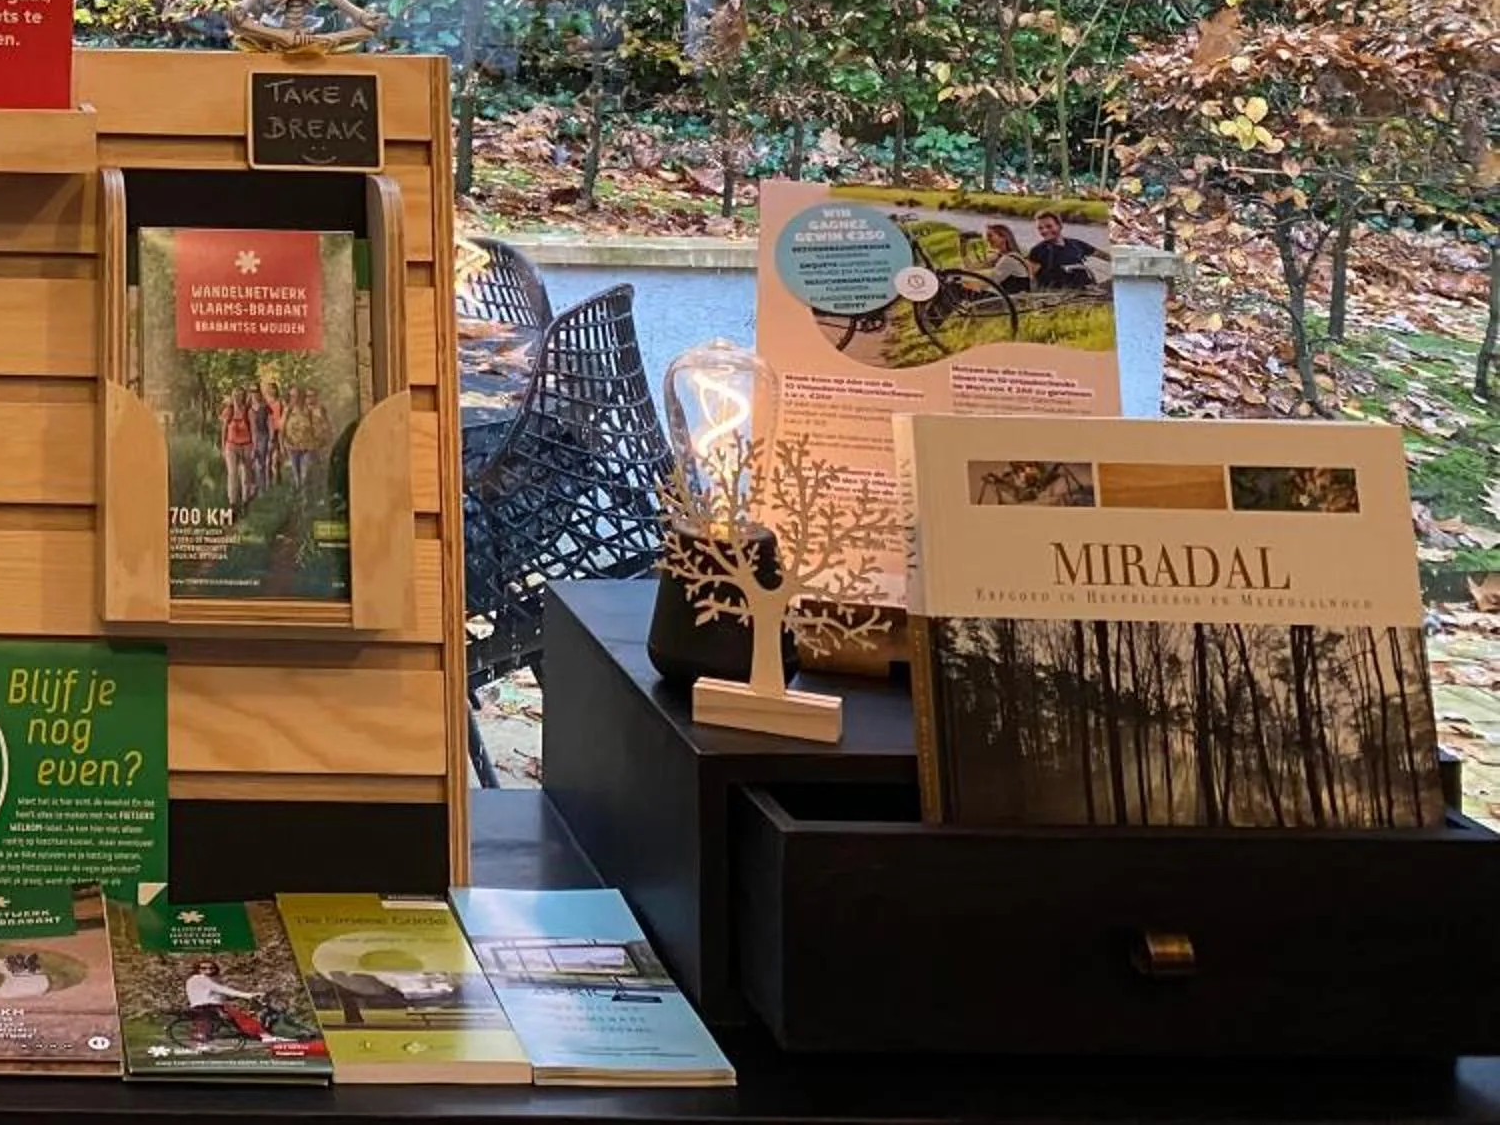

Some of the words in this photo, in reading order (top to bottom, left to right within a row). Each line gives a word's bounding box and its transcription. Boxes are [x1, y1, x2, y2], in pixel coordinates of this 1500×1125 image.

[23, 10, 43, 24] te
[264, 78, 341, 104] TAKE
[350, 86, 369, 111] A
[263, 116, 367, 142] BREAK
[191, 284, 307, 300] WANDELNETWERK
[190, 302, 309, 317] VLAAMS-BRABANT
[170, 508, 201, 525] 700
[207, 508, 233, 525] KM
[1049, 541, 1291, 590] MIRADAL
[8, 669, 77, 713] Blijf
[81, 671, 117, 714] je
[28, 718, 92, 754] nog
[37, 751, 143, 787] even?
